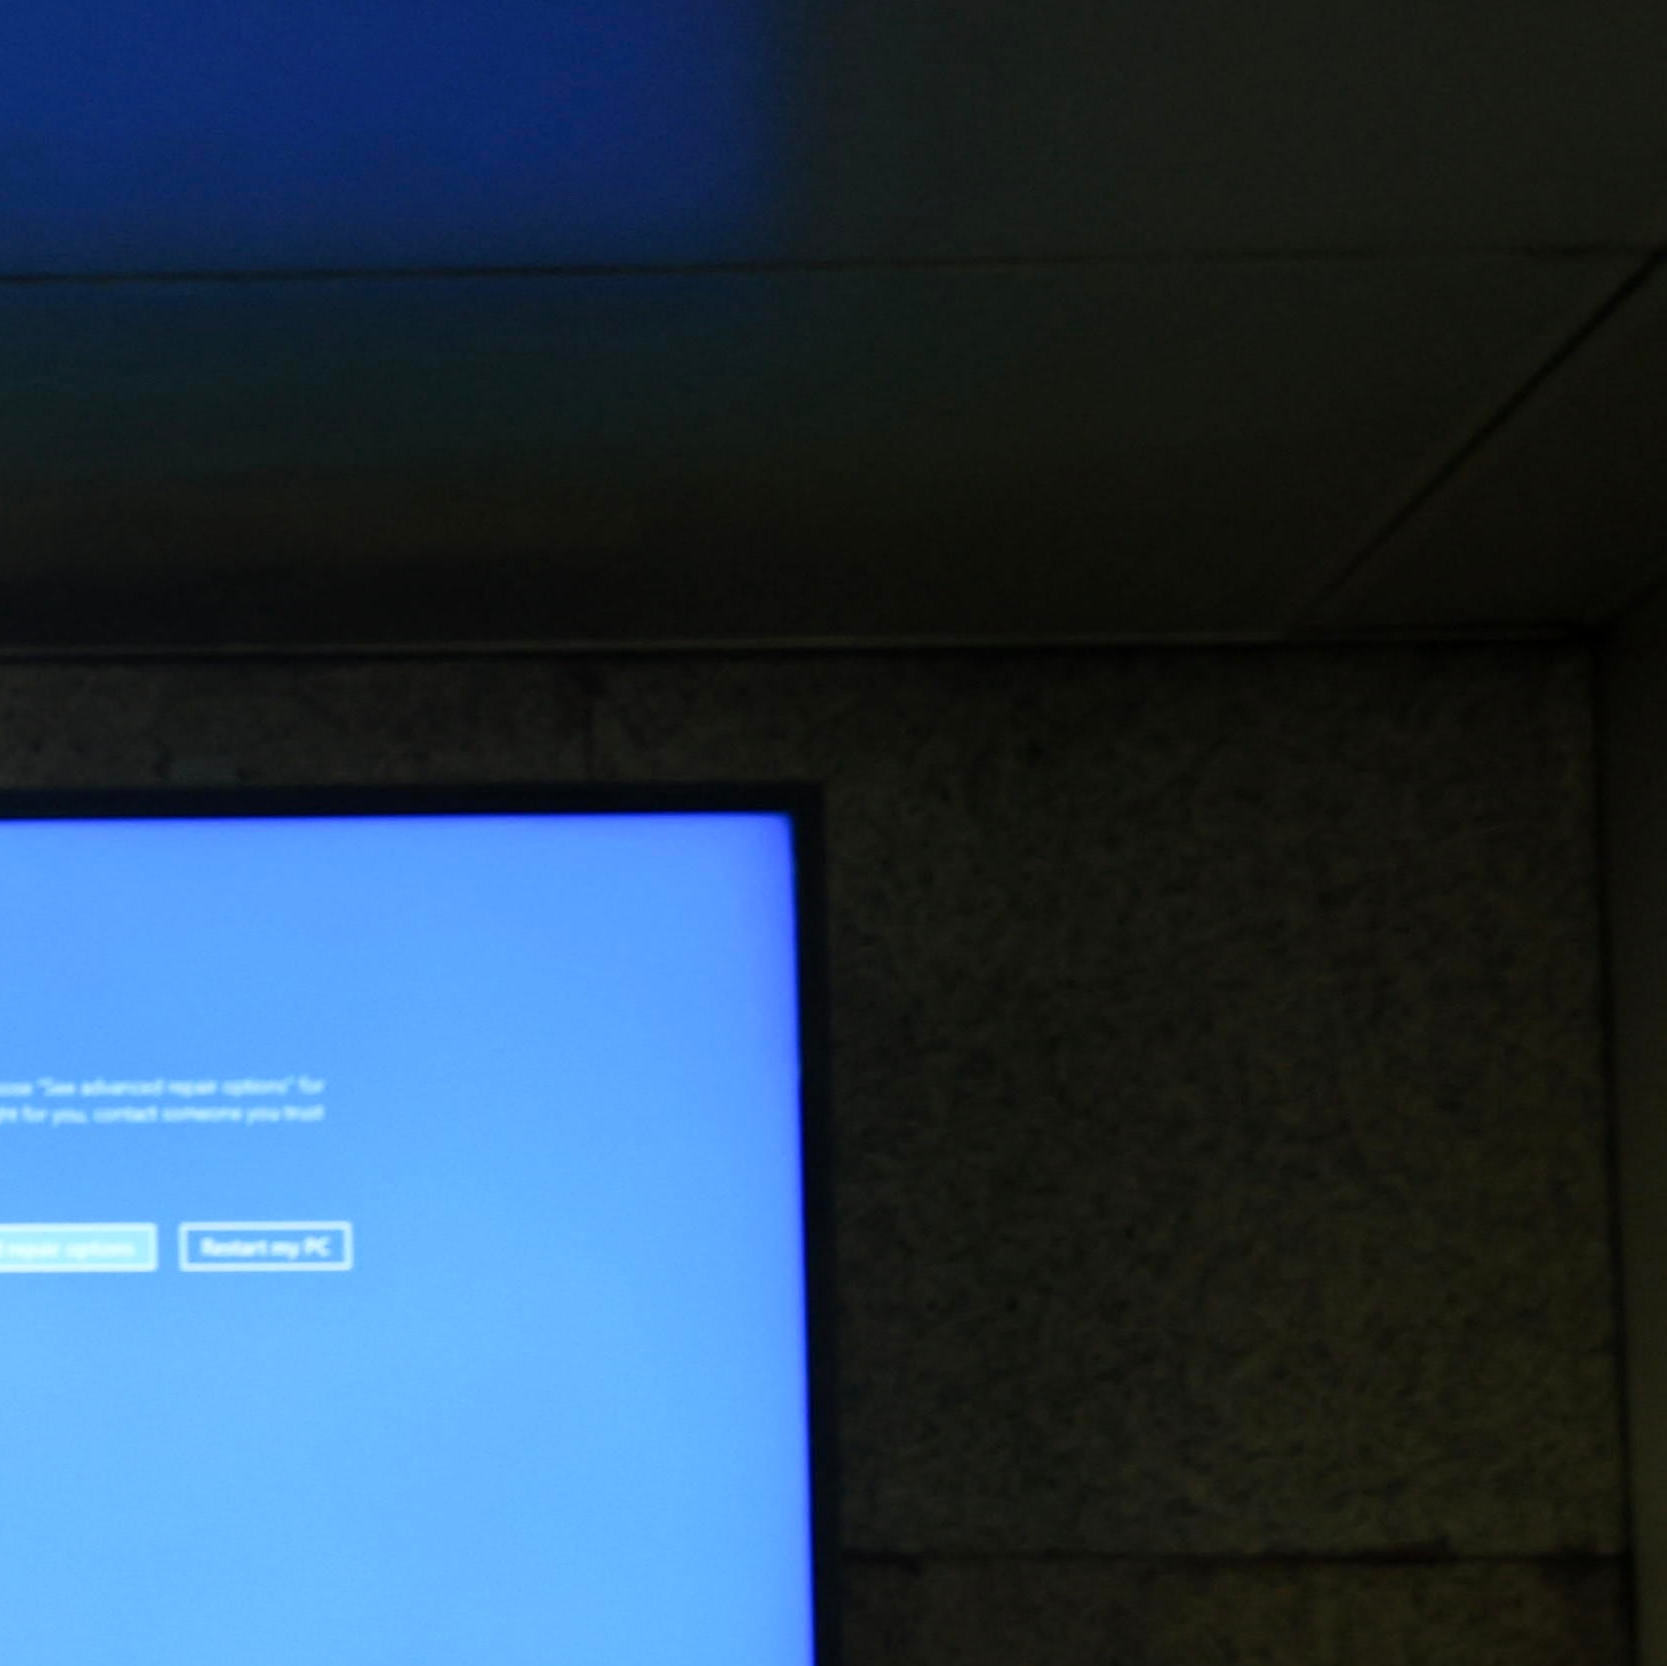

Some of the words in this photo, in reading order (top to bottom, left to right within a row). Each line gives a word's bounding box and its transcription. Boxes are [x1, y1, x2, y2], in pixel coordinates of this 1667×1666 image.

[200, 1237, 265, 1259] Restart
[268, 1241, 298, 1262] my
[300, 1236, 328, 1258] PC
